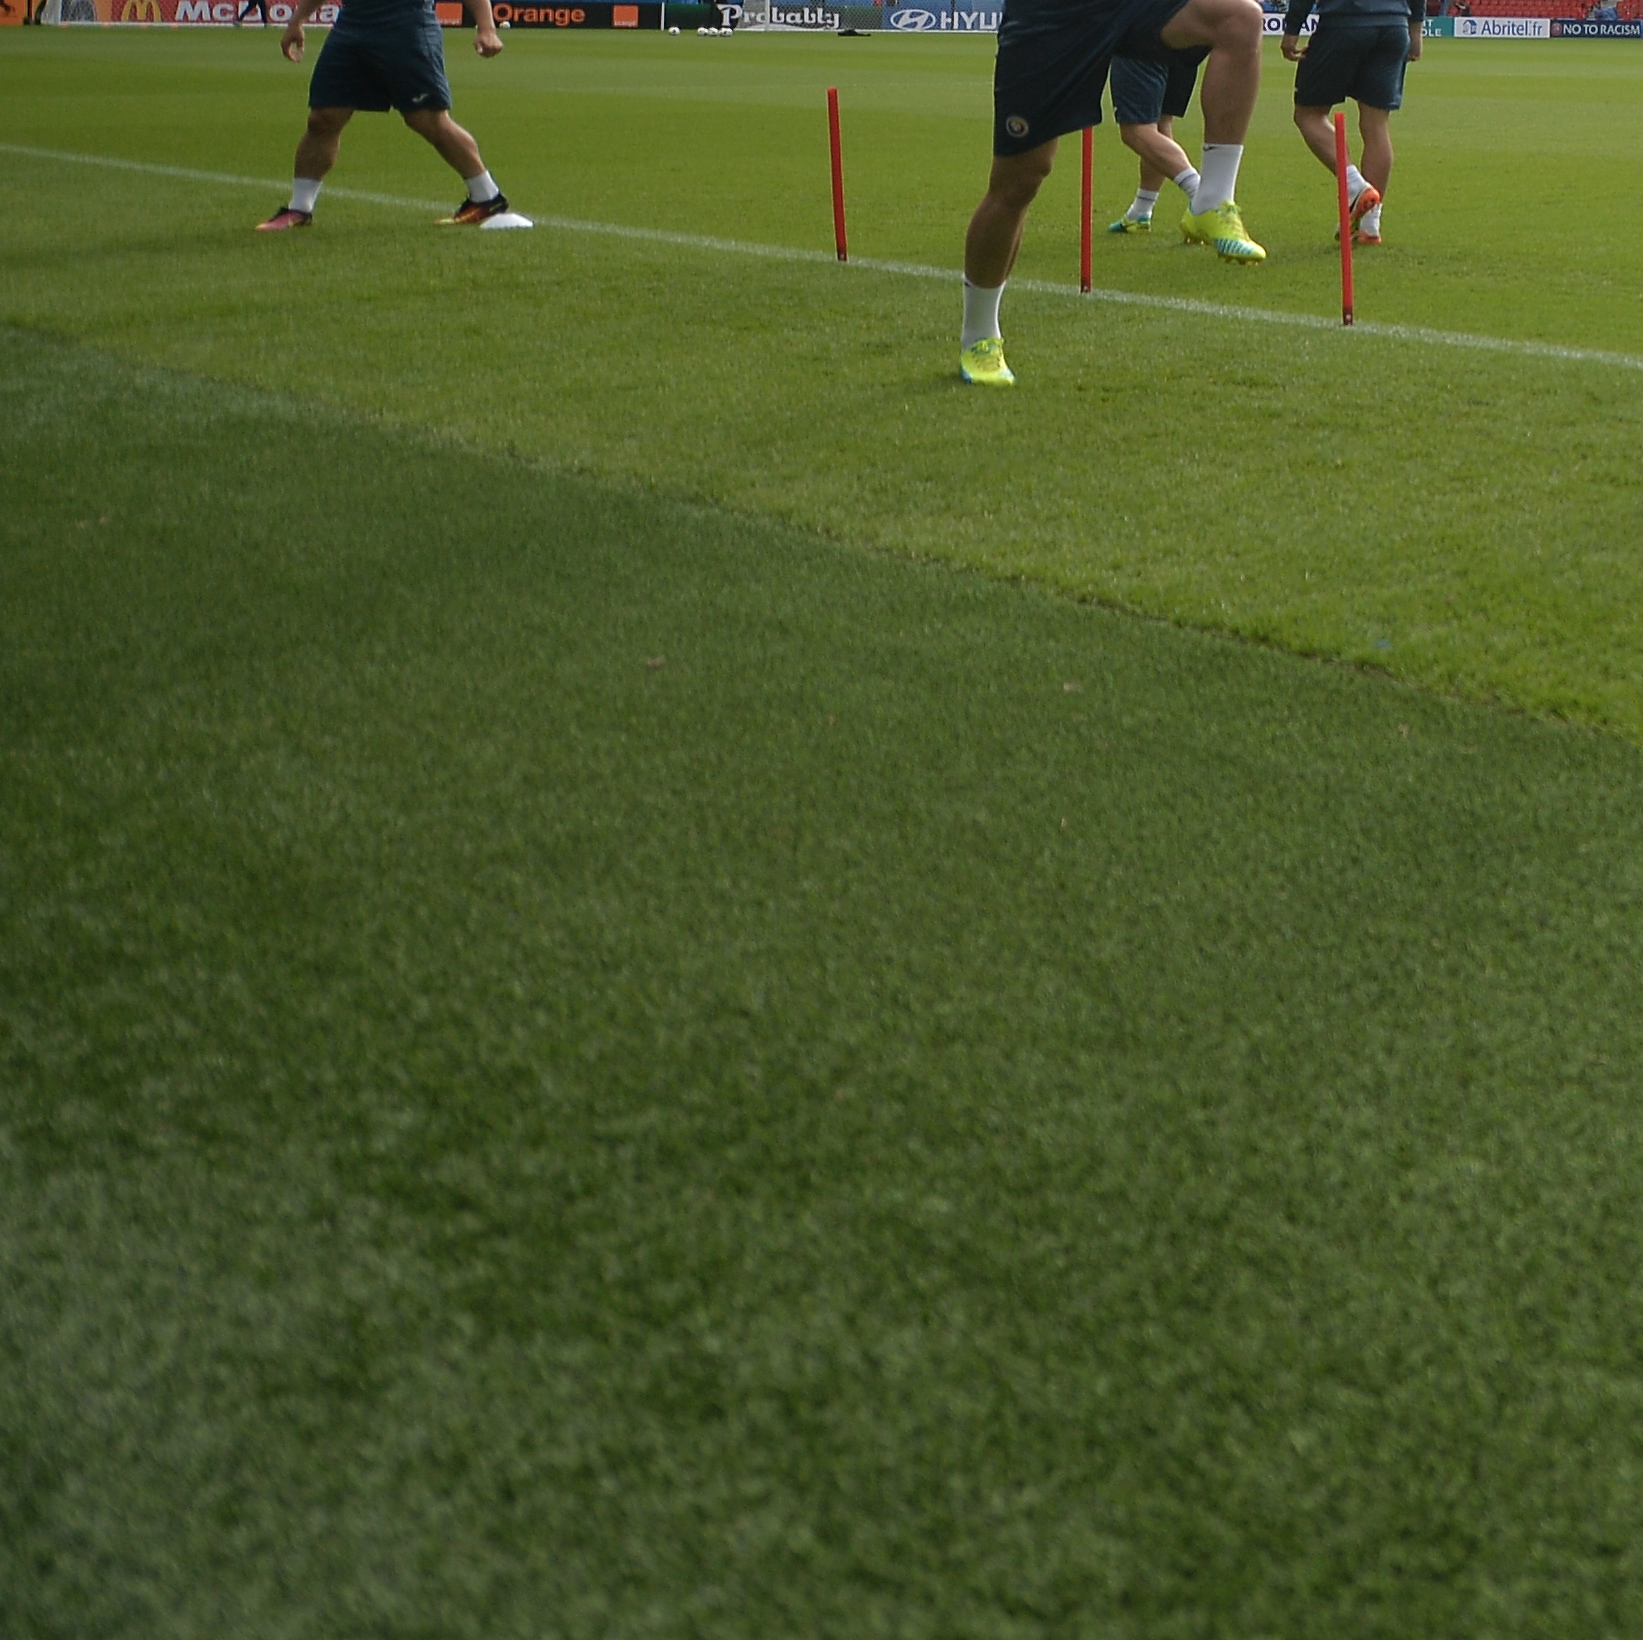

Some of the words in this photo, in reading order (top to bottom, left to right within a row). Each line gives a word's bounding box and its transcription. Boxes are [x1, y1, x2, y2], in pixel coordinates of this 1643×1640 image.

[493, 2, 586, 26] Orange
[940, 11, 1003, 30] HYU
[1481, 18, 1543, 37] Abritel.fr
[1563, 24, 1581, 35] NO
[1582, 24, 1599, 35] TO
[1600, 24, 1641, 36] RACISM
